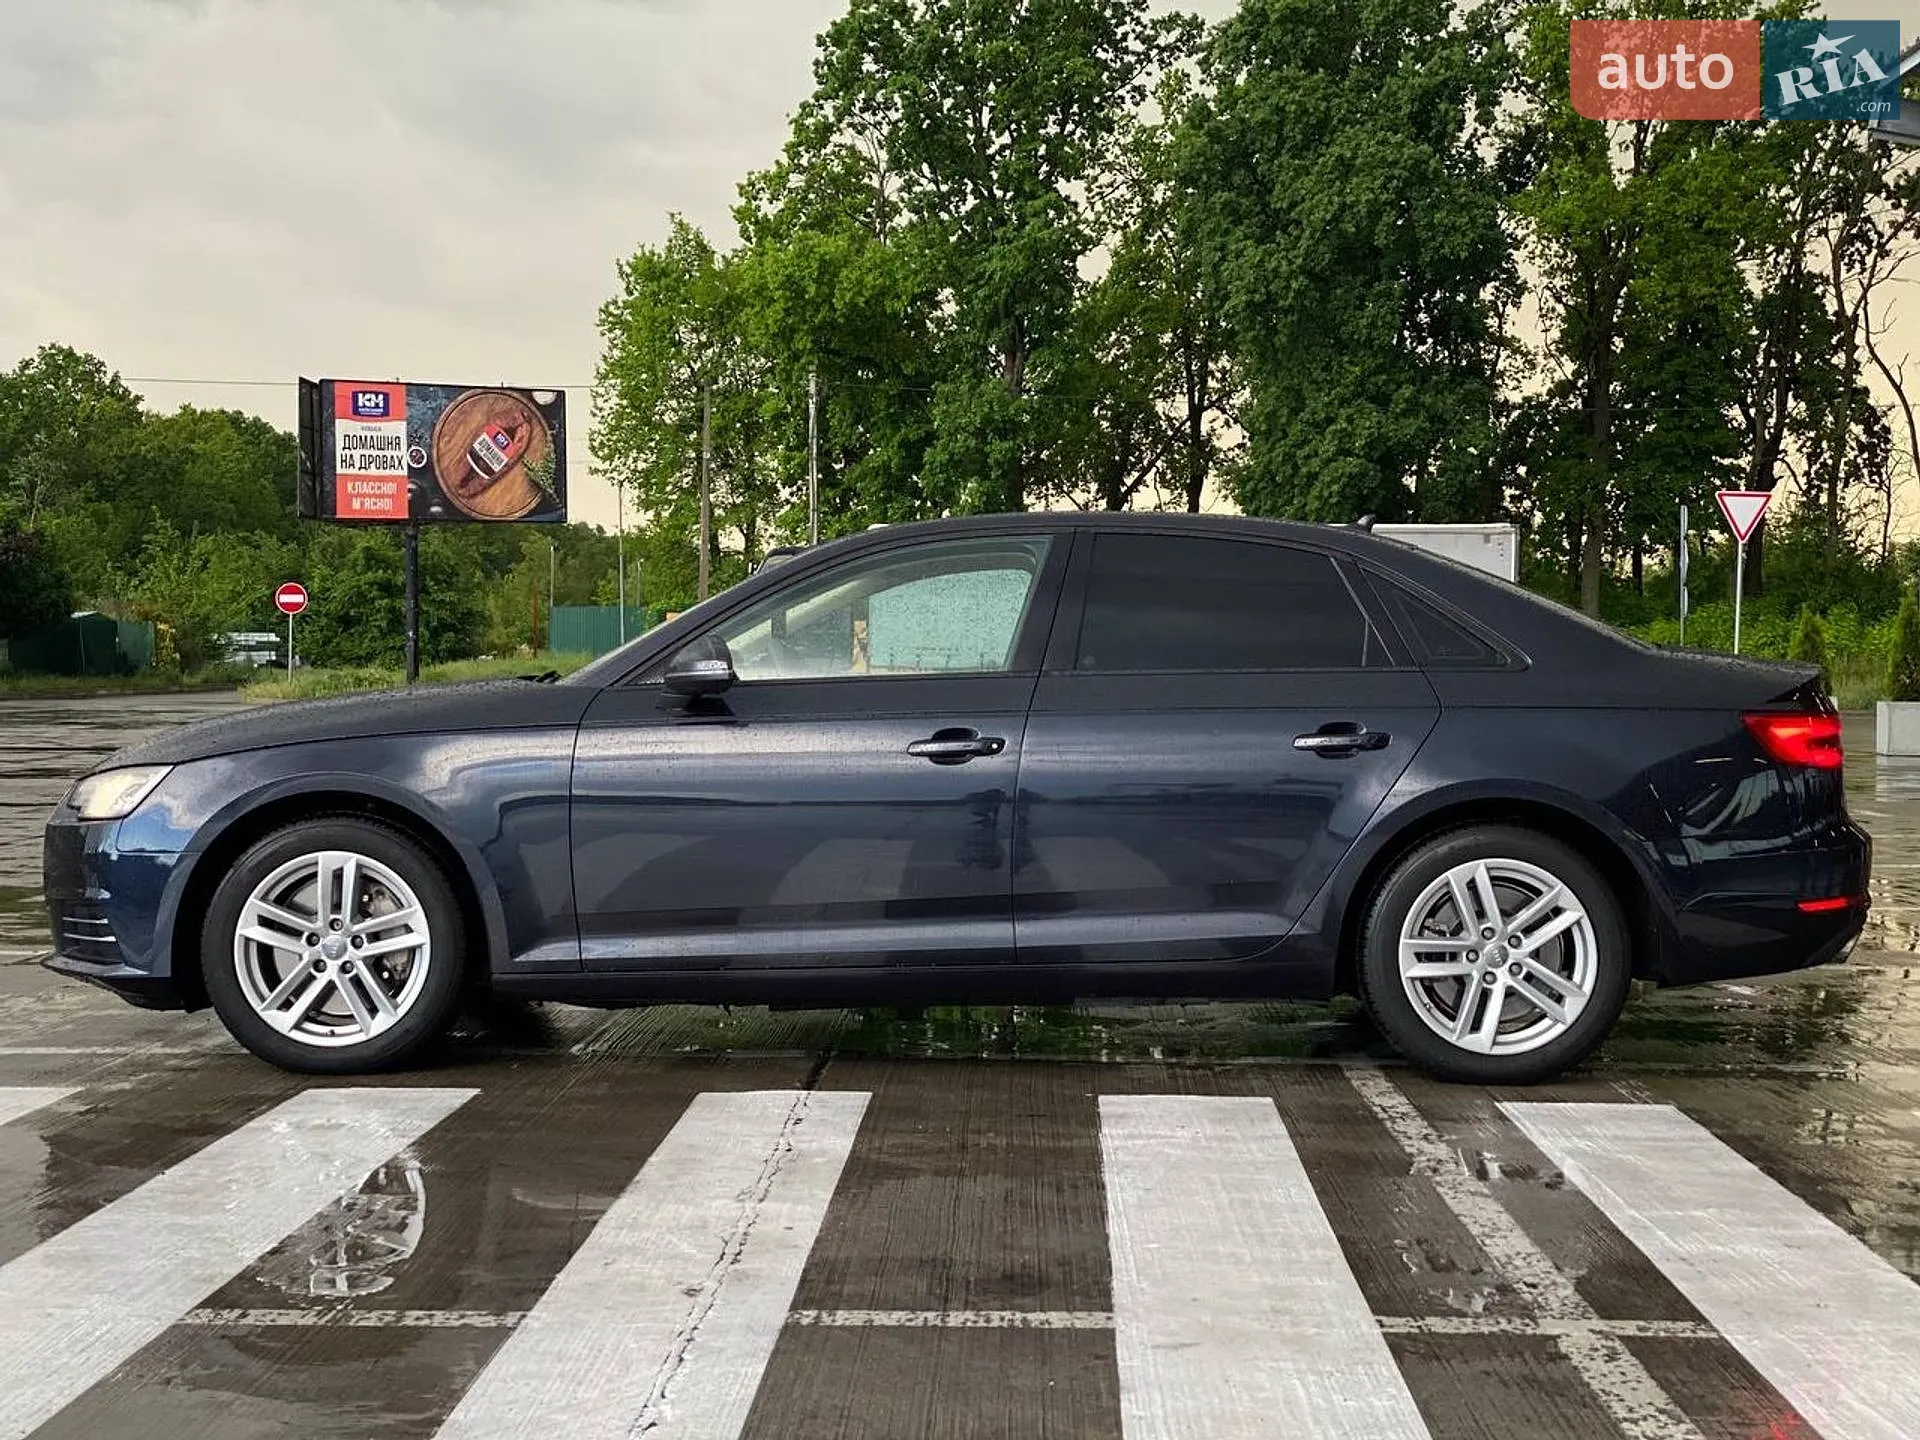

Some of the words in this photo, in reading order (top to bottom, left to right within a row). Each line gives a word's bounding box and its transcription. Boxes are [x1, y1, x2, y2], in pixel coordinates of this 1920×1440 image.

[342, 434, 401, 451] ДОМАШНЯ
[340, 453, 355, 470] НА
[358, 454, 404, 471] ДРОВАХ
